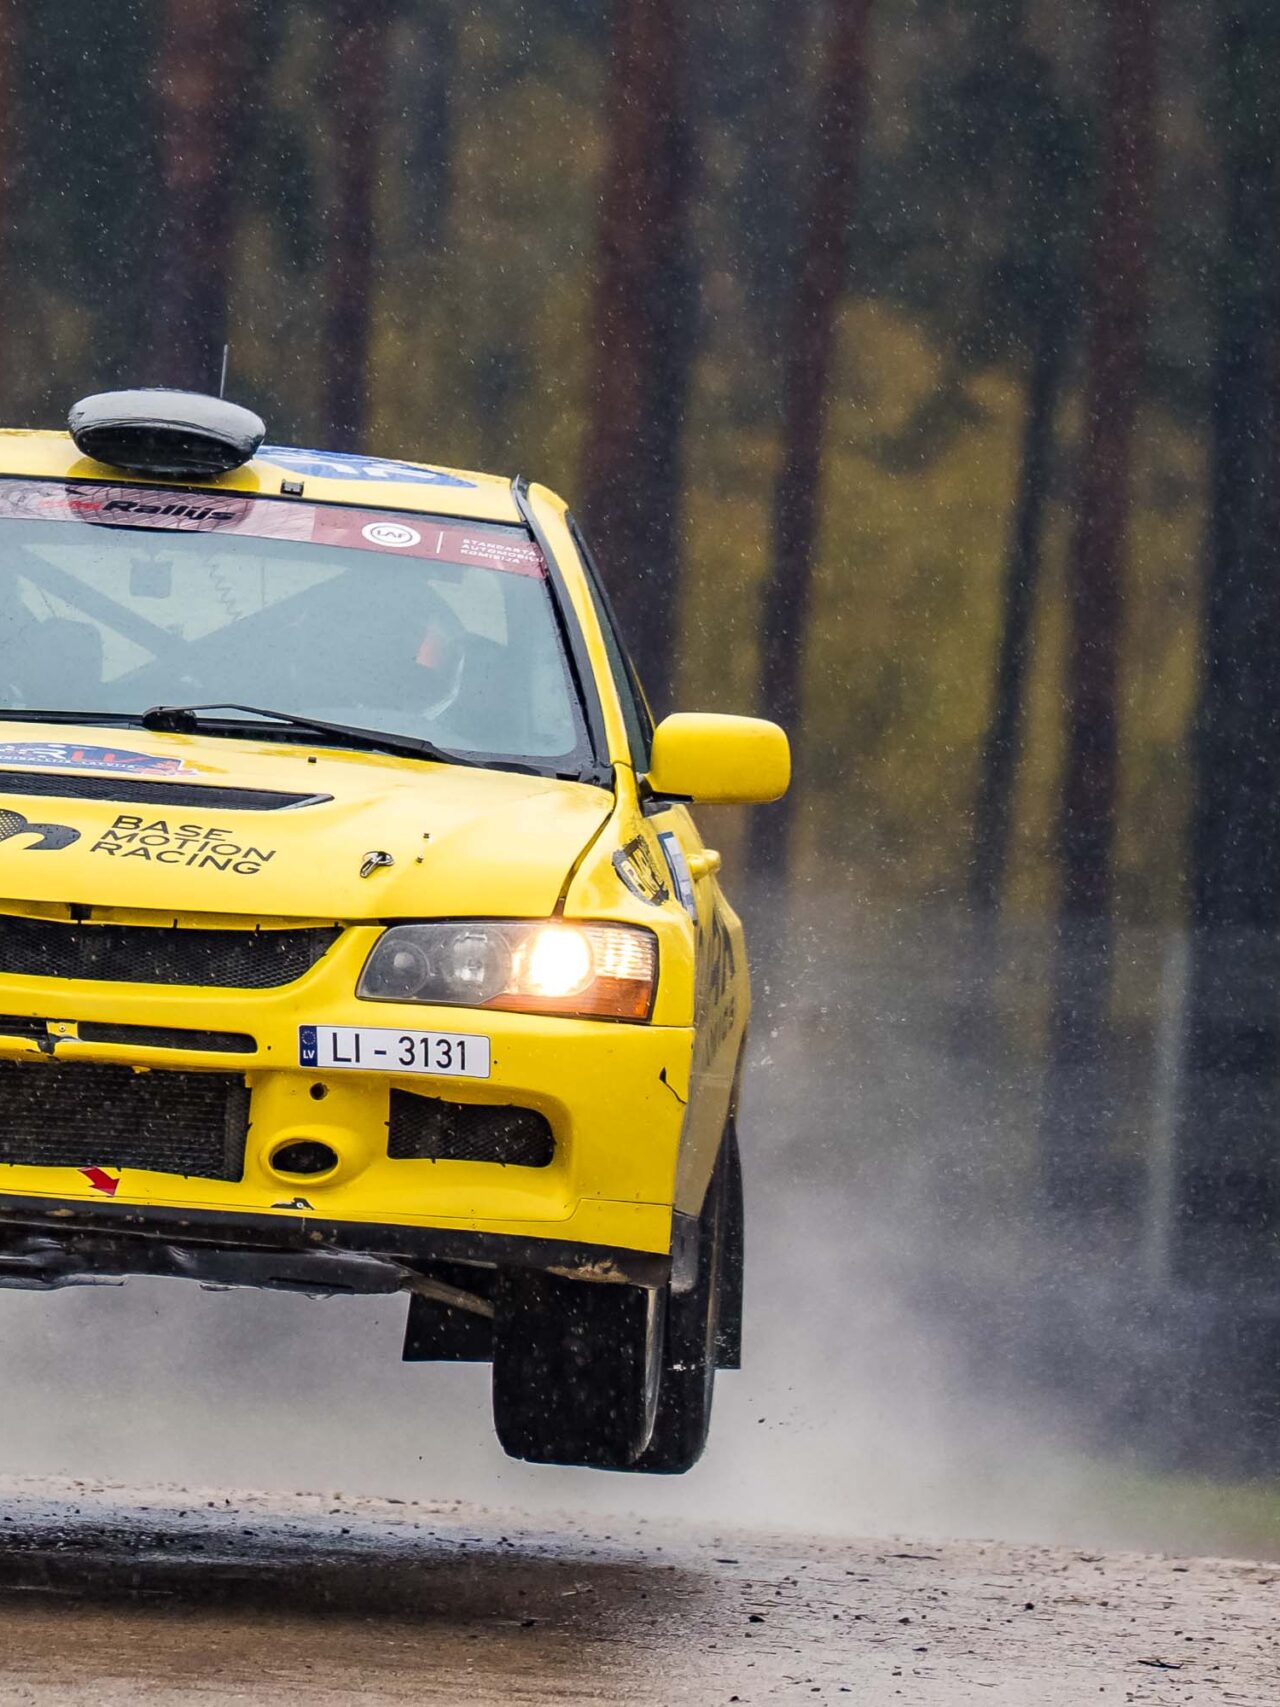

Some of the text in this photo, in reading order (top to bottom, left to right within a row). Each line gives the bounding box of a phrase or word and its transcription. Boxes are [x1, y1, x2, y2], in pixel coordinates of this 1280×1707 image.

[376, 530, 408, 539] LAF
[462, 538, 537, 556] STANDARTA
[111, 814, 233, 842] BASE
[100, 829, 277, 862] MOTION
[89, 840, 262, 875] RACING
[302, 1050, 315, 1059] LV
